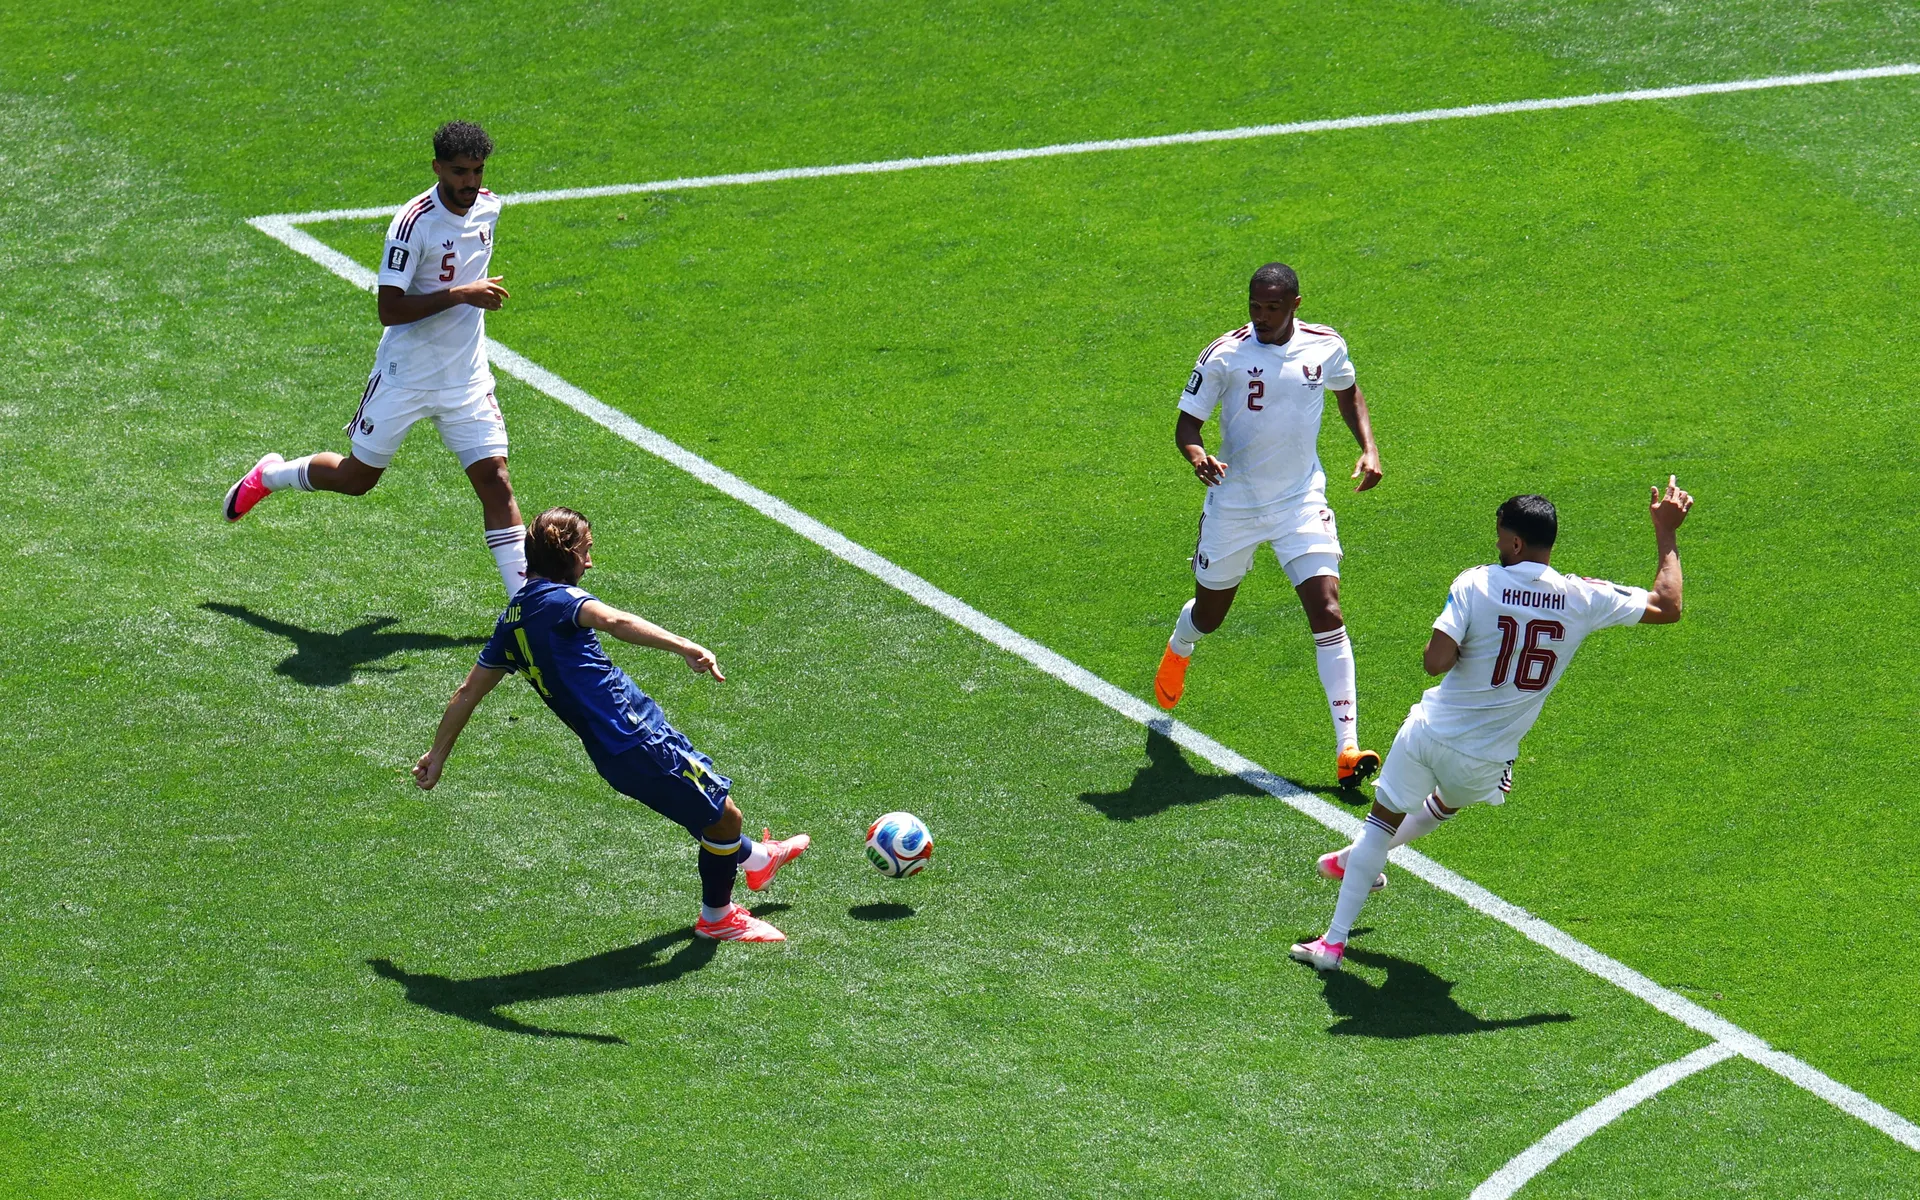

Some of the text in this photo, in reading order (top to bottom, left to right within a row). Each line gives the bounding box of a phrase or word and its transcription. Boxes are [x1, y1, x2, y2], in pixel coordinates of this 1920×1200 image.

[439, 252, 455, 281] 5
[1248, 380, 1264, 411] 2
[1502, 588, 1565, 610] KHOUKHI
[1491, 615, 1566, 693] 16
